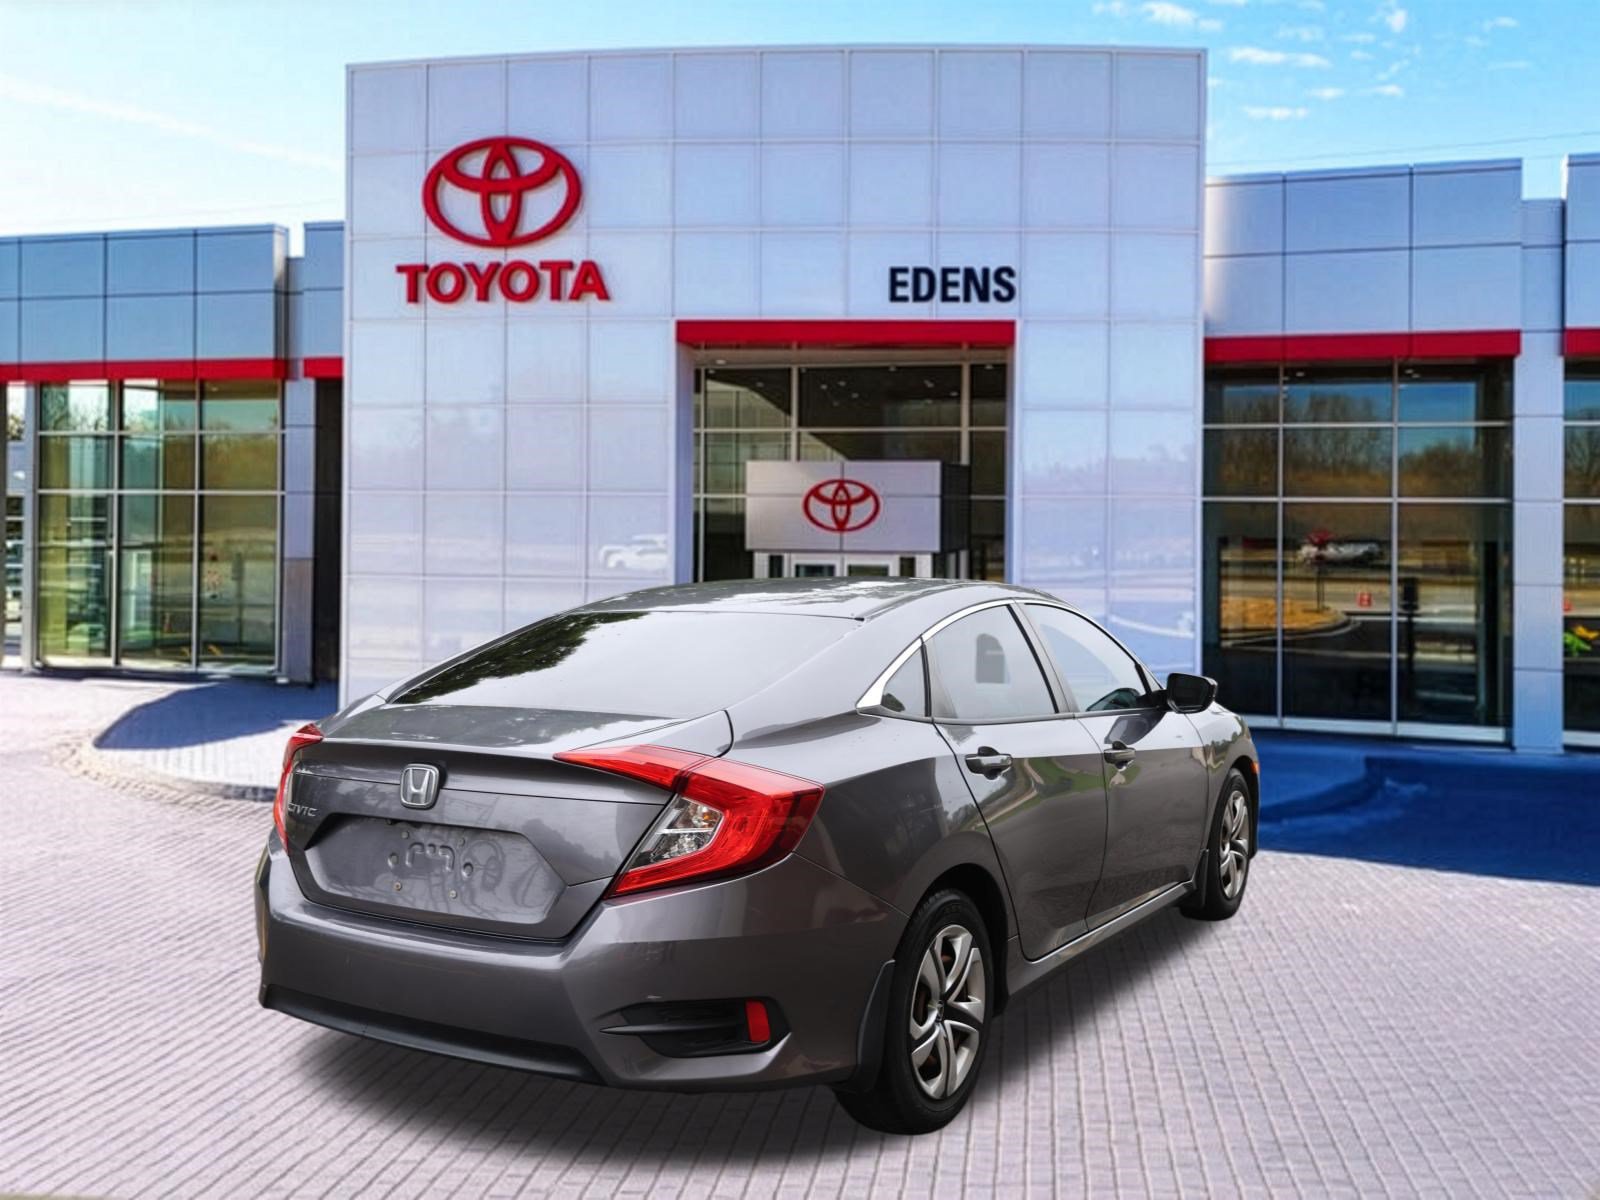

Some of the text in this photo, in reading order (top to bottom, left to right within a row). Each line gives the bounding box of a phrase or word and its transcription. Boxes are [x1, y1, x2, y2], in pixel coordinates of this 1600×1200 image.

[396, 259, 610, 303] TOYOTA
[889, 266, 1017, 303] EDENS
[287, 802, 318, 817] CIVIC
